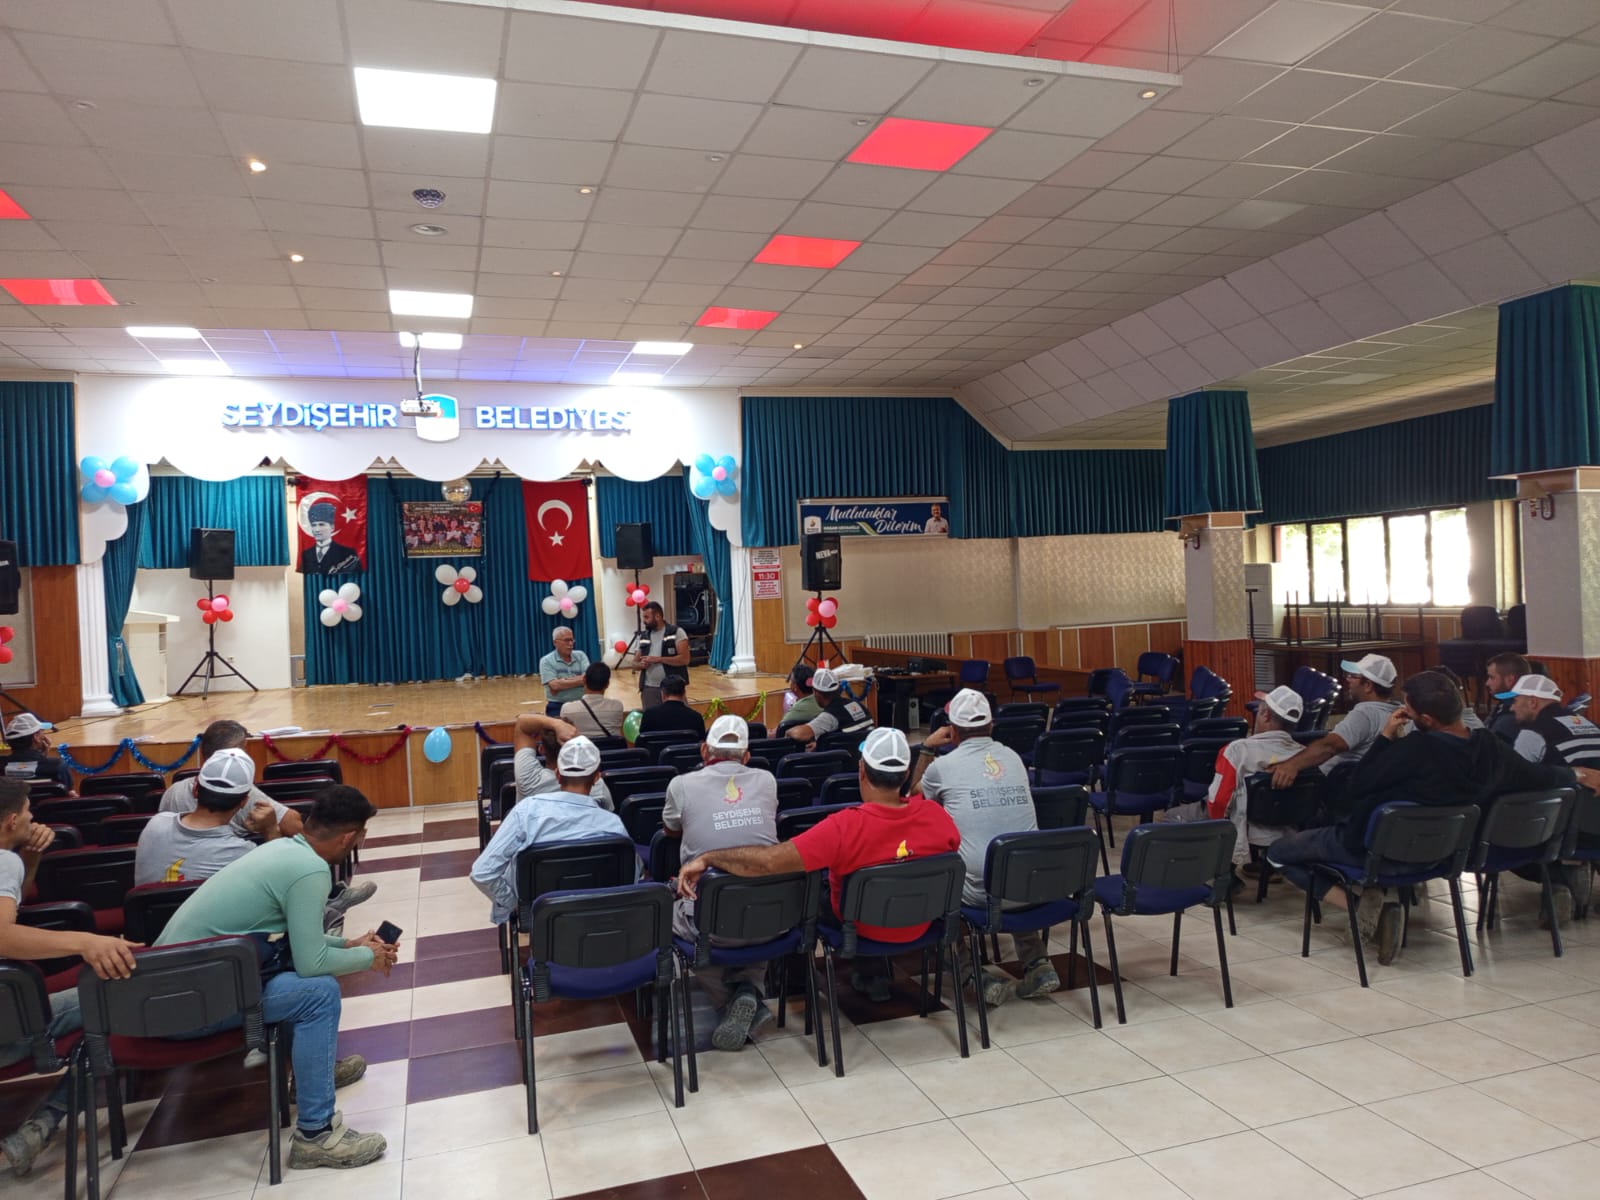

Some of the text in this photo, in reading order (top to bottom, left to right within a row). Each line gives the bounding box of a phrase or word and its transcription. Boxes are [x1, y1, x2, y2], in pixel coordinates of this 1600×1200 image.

[475, 405, 631, 430] BELEDİYES
[825, 505, 897, 521] Mutluluklar
[874, 519, 923, 534] Dilerim
